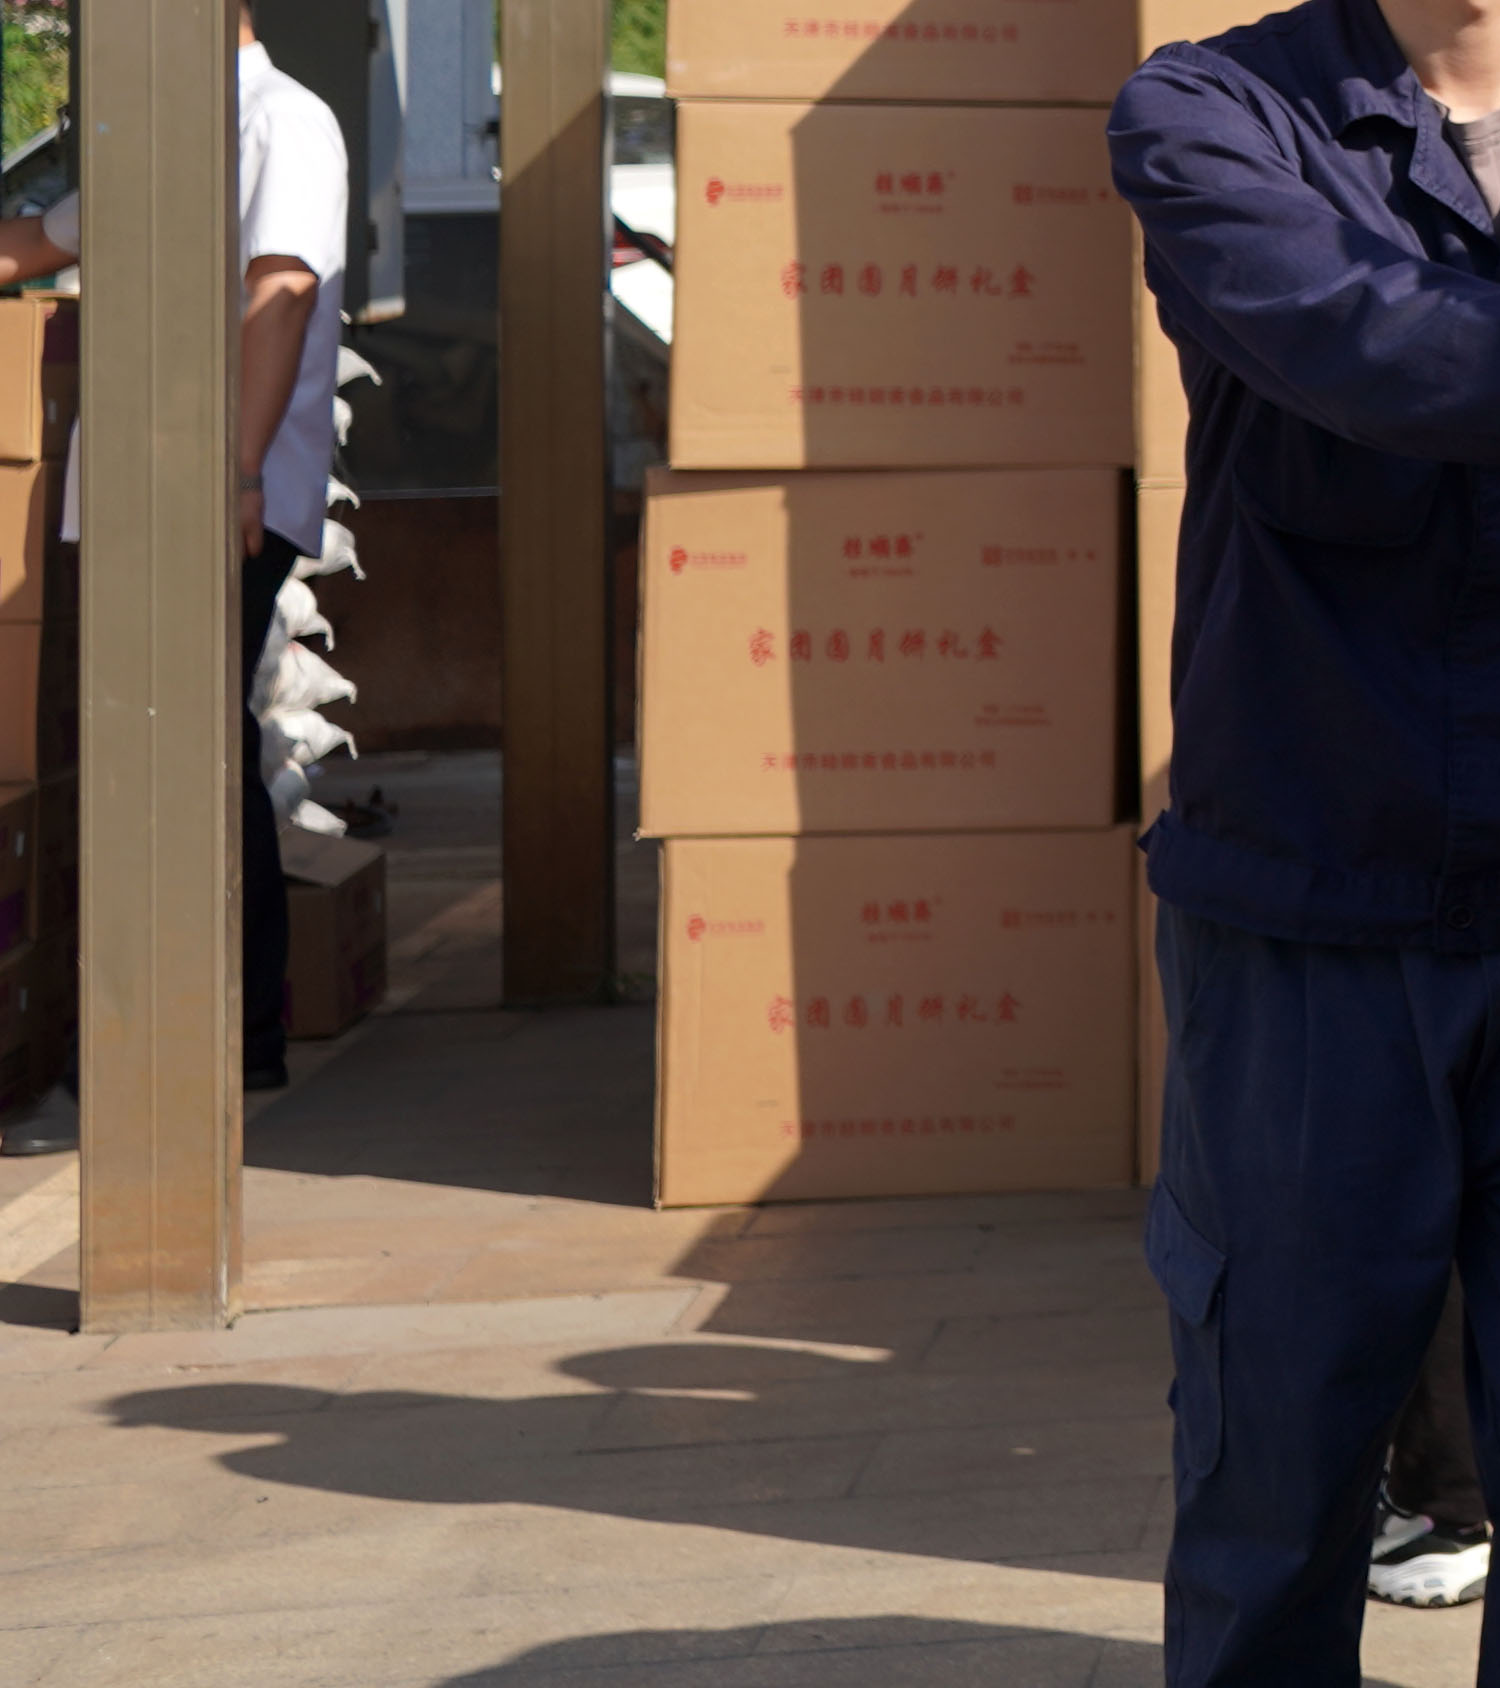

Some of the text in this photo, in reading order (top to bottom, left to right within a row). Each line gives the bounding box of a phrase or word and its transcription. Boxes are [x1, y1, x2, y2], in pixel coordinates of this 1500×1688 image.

[780, 259, 1036, 300] 家团圆月饼礼盒
[749, 626, 1004, 666] 家团圆月饼礼盒
[767, 992, 1021, 1034] 家团圆月饼礼盒
